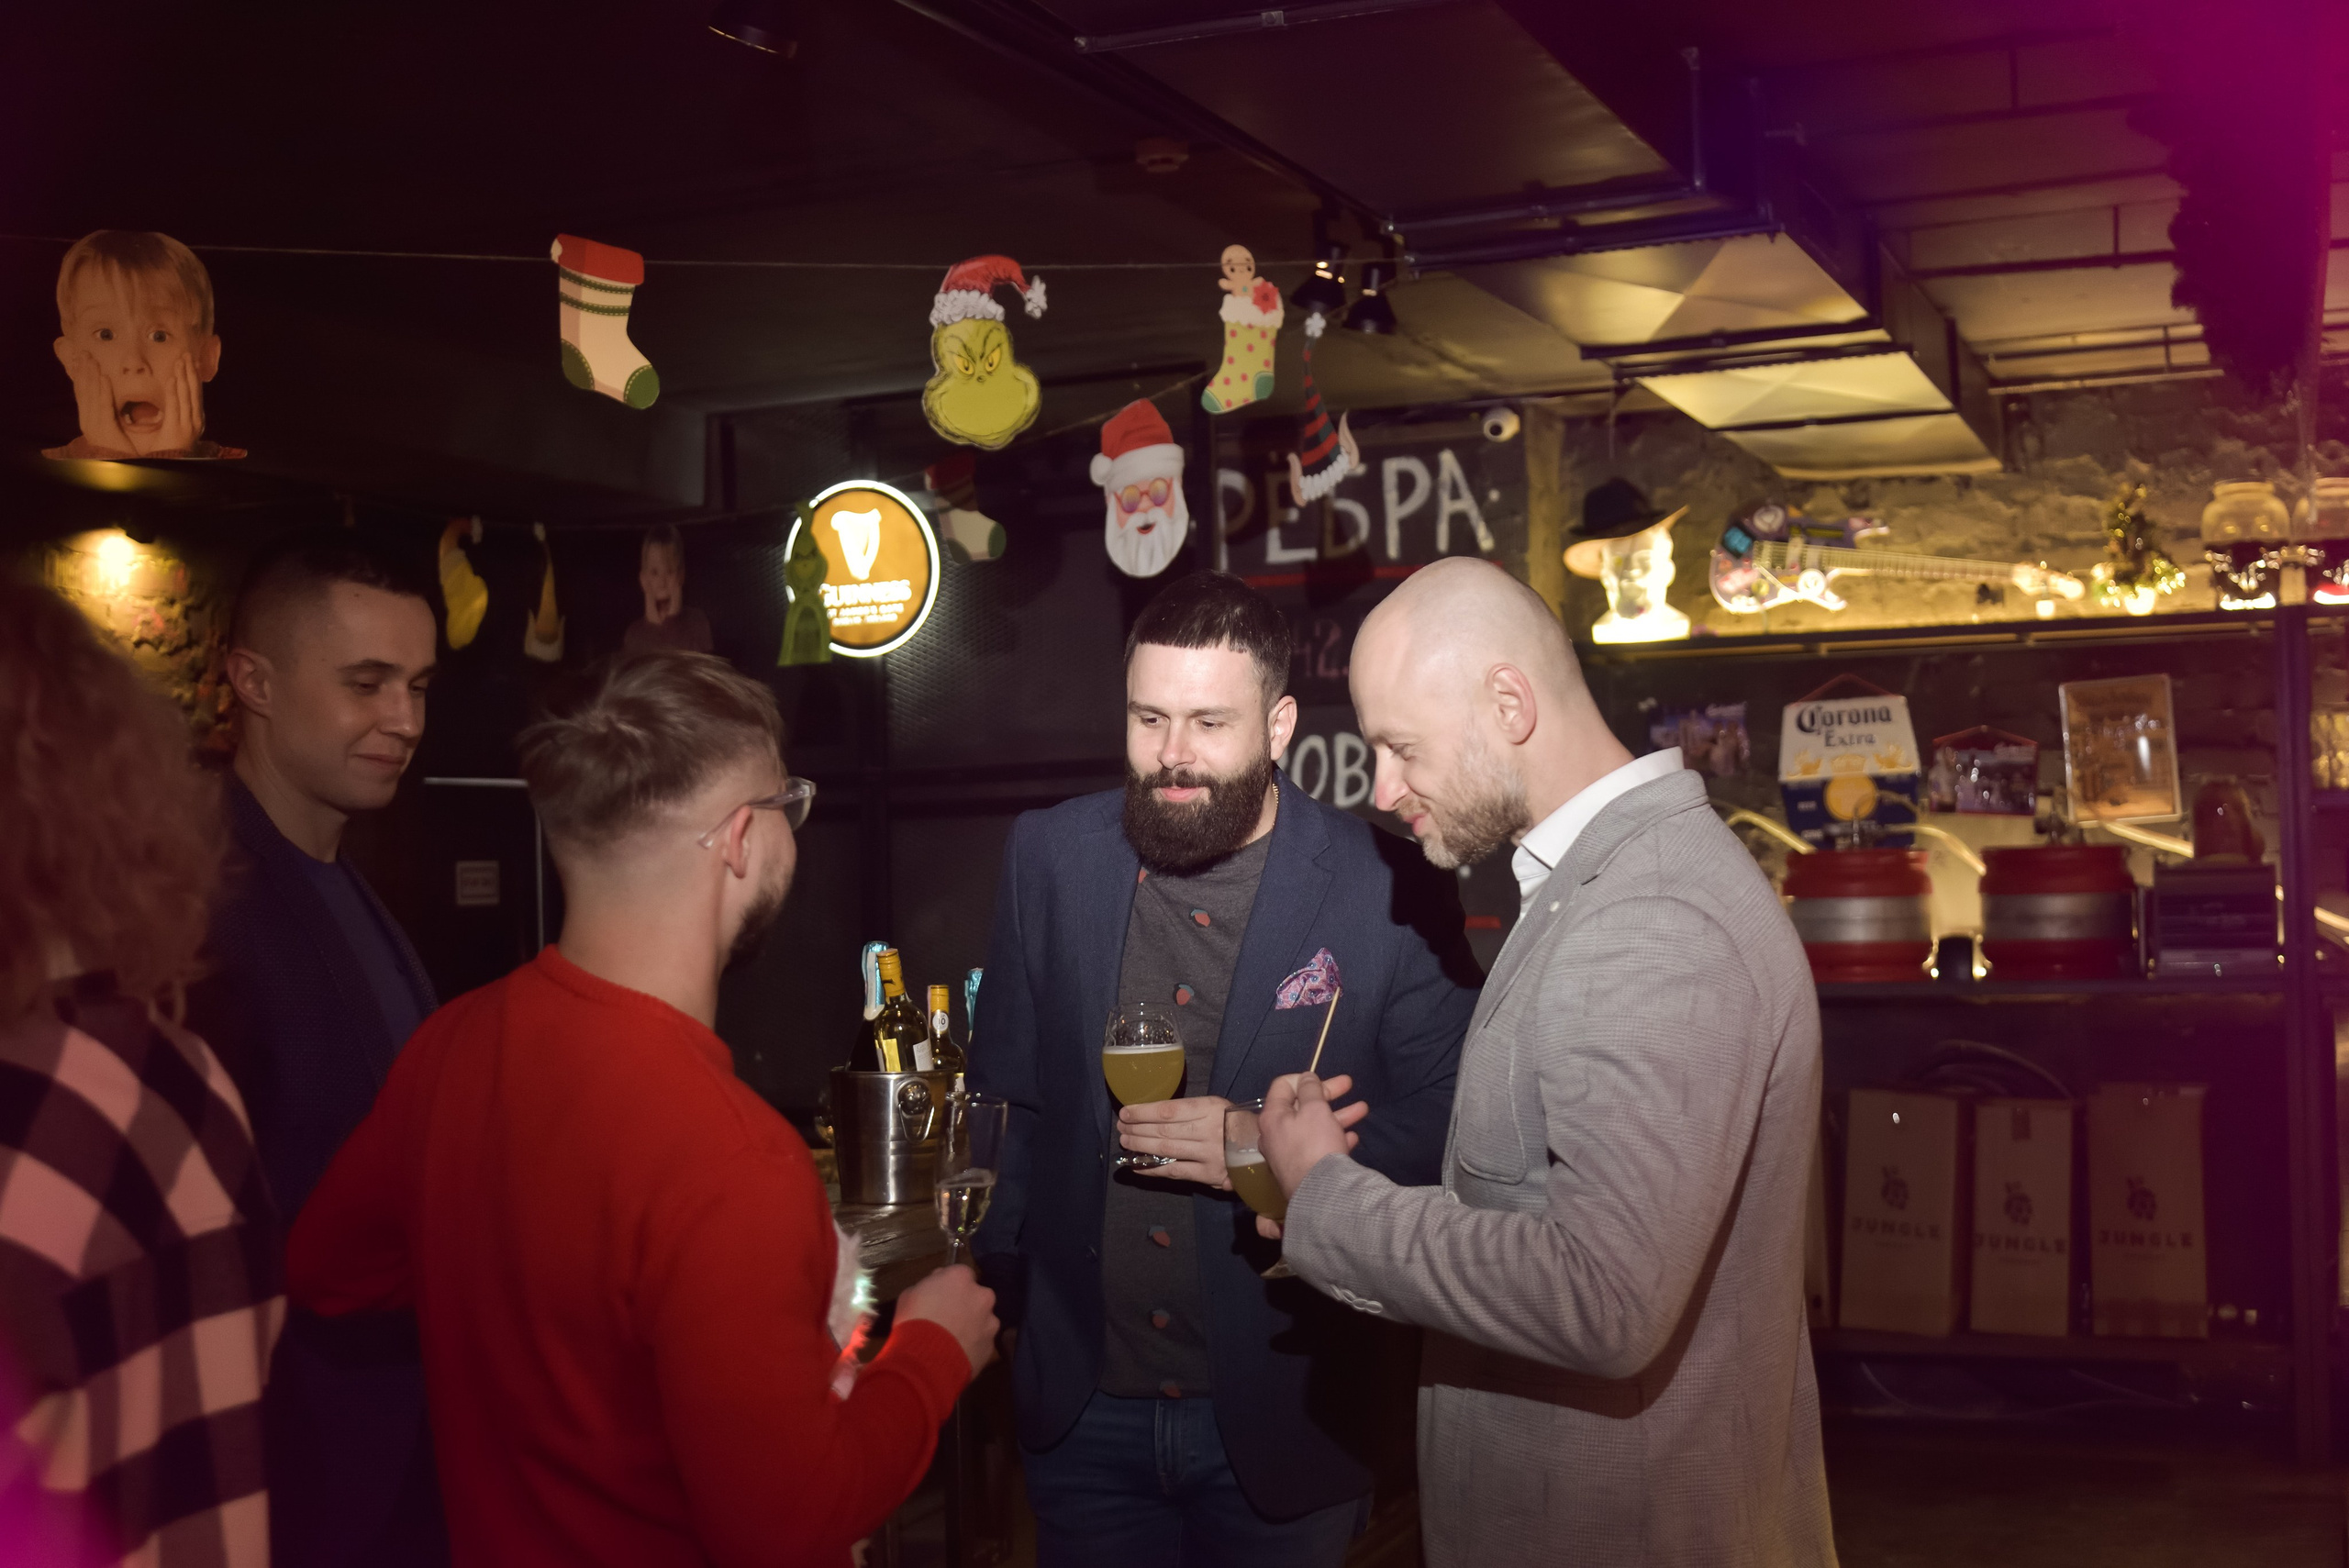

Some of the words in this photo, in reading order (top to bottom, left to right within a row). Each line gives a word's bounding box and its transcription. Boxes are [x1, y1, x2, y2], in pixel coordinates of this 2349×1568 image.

[1797, 704, 1892, 736] Corona
[1823, 729, 1876, 748] Extra
[1851, 1216, 1941, 1240] JUNGLE
[2099, 1229, 2193, 1248] JUNGLE
[1973, 1232, 2066, 1254] JUNGLE
